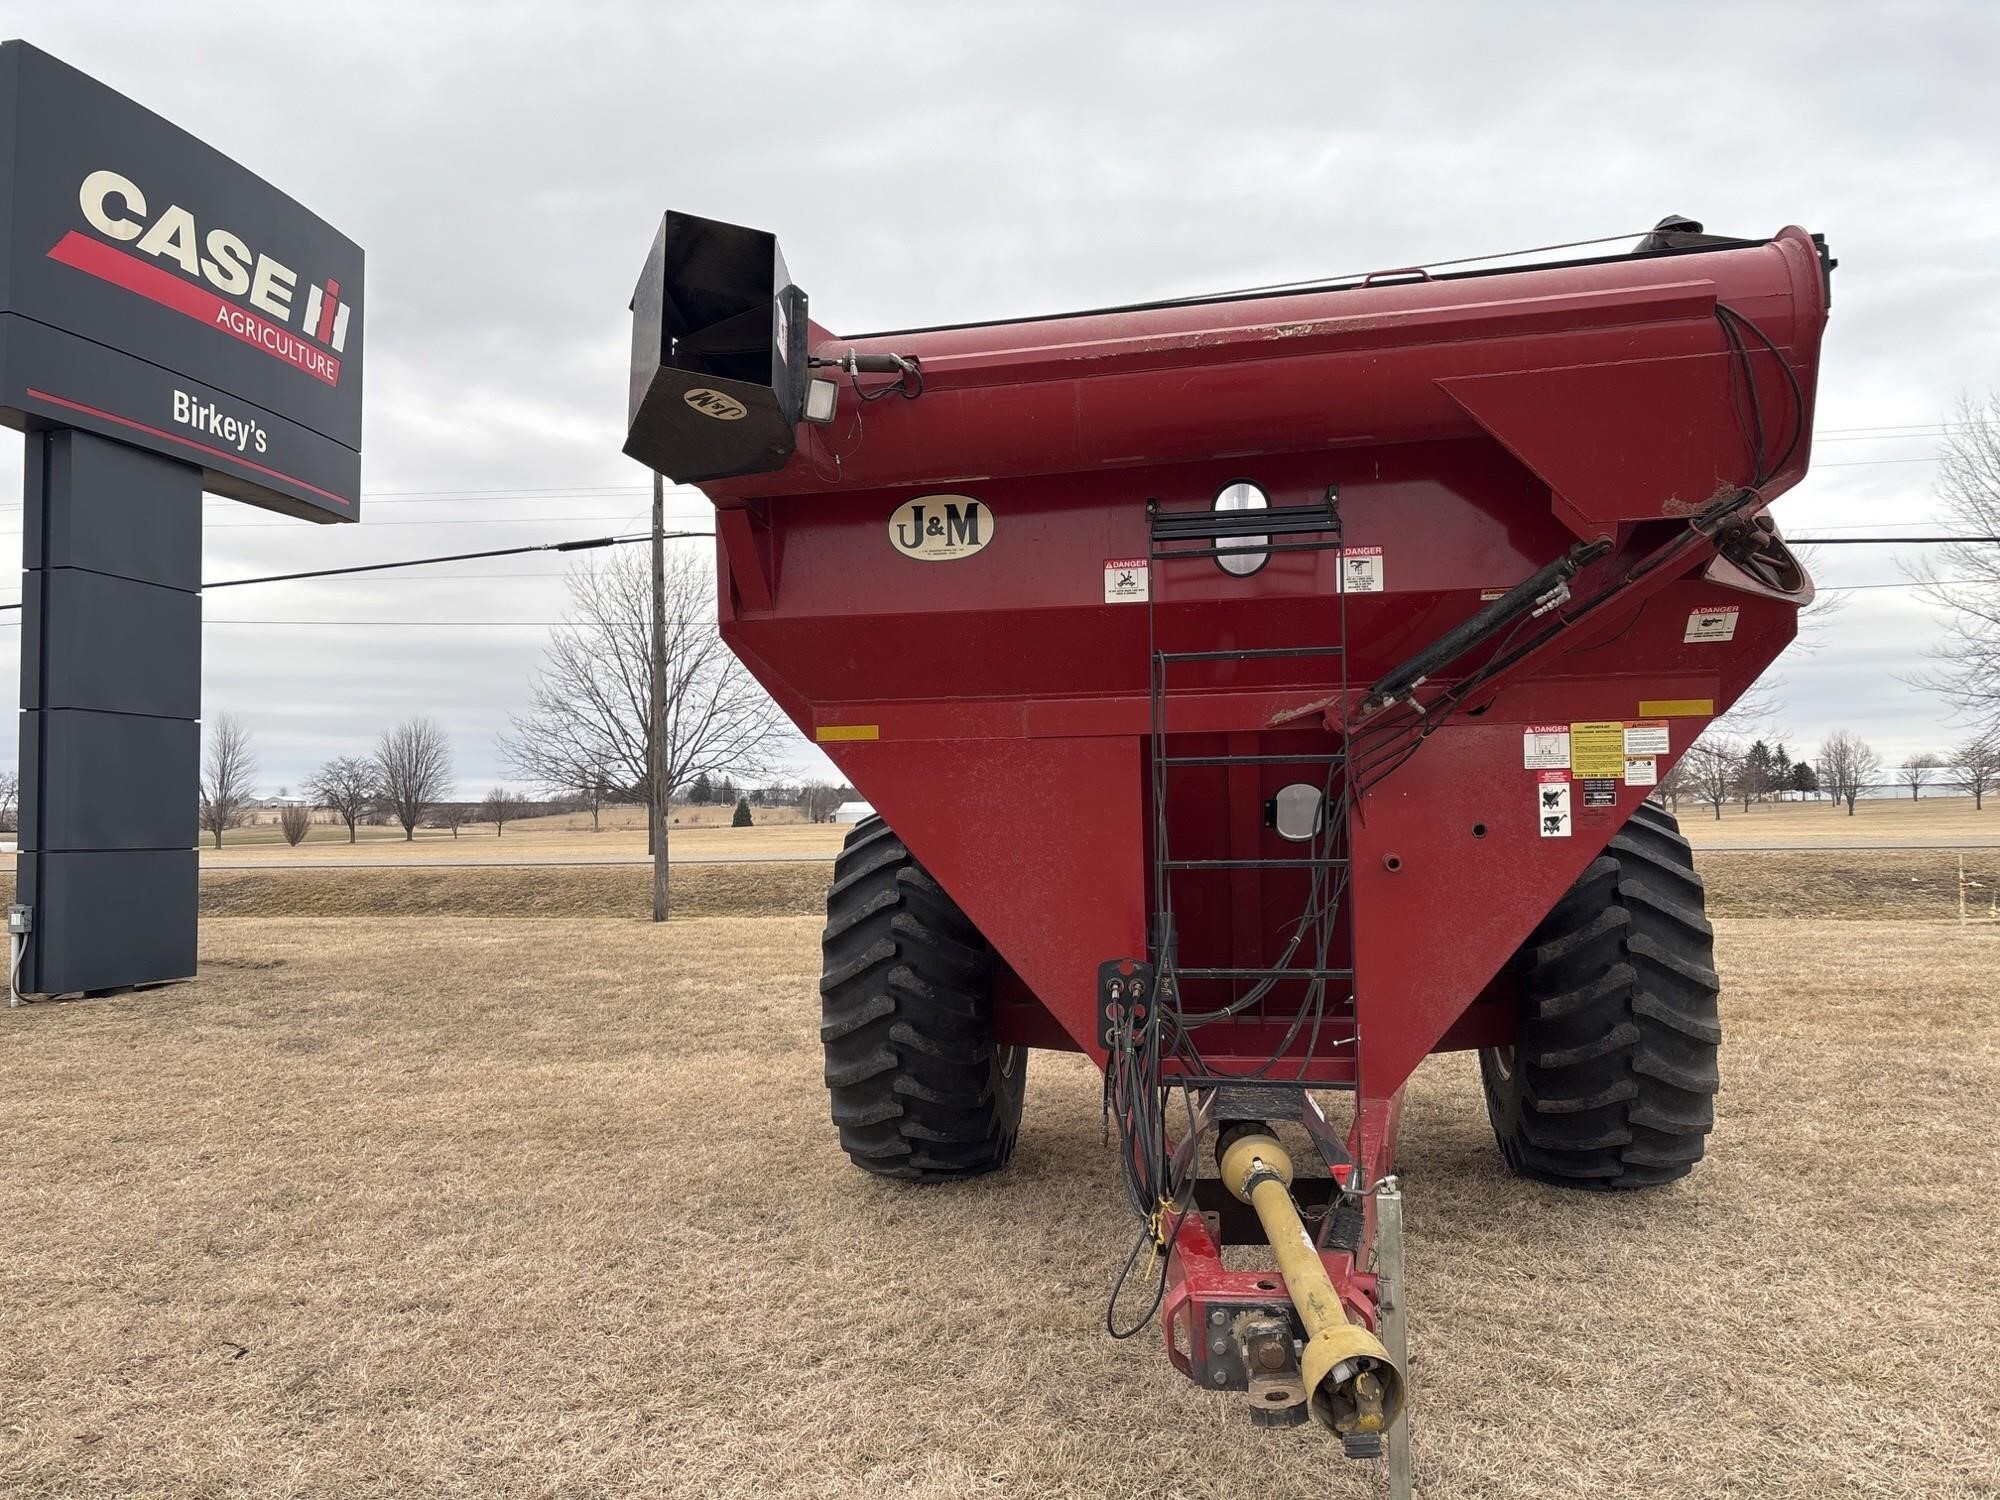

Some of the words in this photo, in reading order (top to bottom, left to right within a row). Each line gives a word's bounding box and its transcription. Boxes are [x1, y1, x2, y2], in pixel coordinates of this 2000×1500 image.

[79, 170, 298, 322] CASE
[216, 305, 335, 381] AGRICULTURE
[173, 389, 267, 453] Birkey's
[896, 502, 982, 549] J&M
[1113, 560, 1148, 568] DANGER
[1345, 547, 1382, 556] DANGER
[1700, 605, 1740, 613] DANGER
[1534, 725, 1569, 733] DANGER
